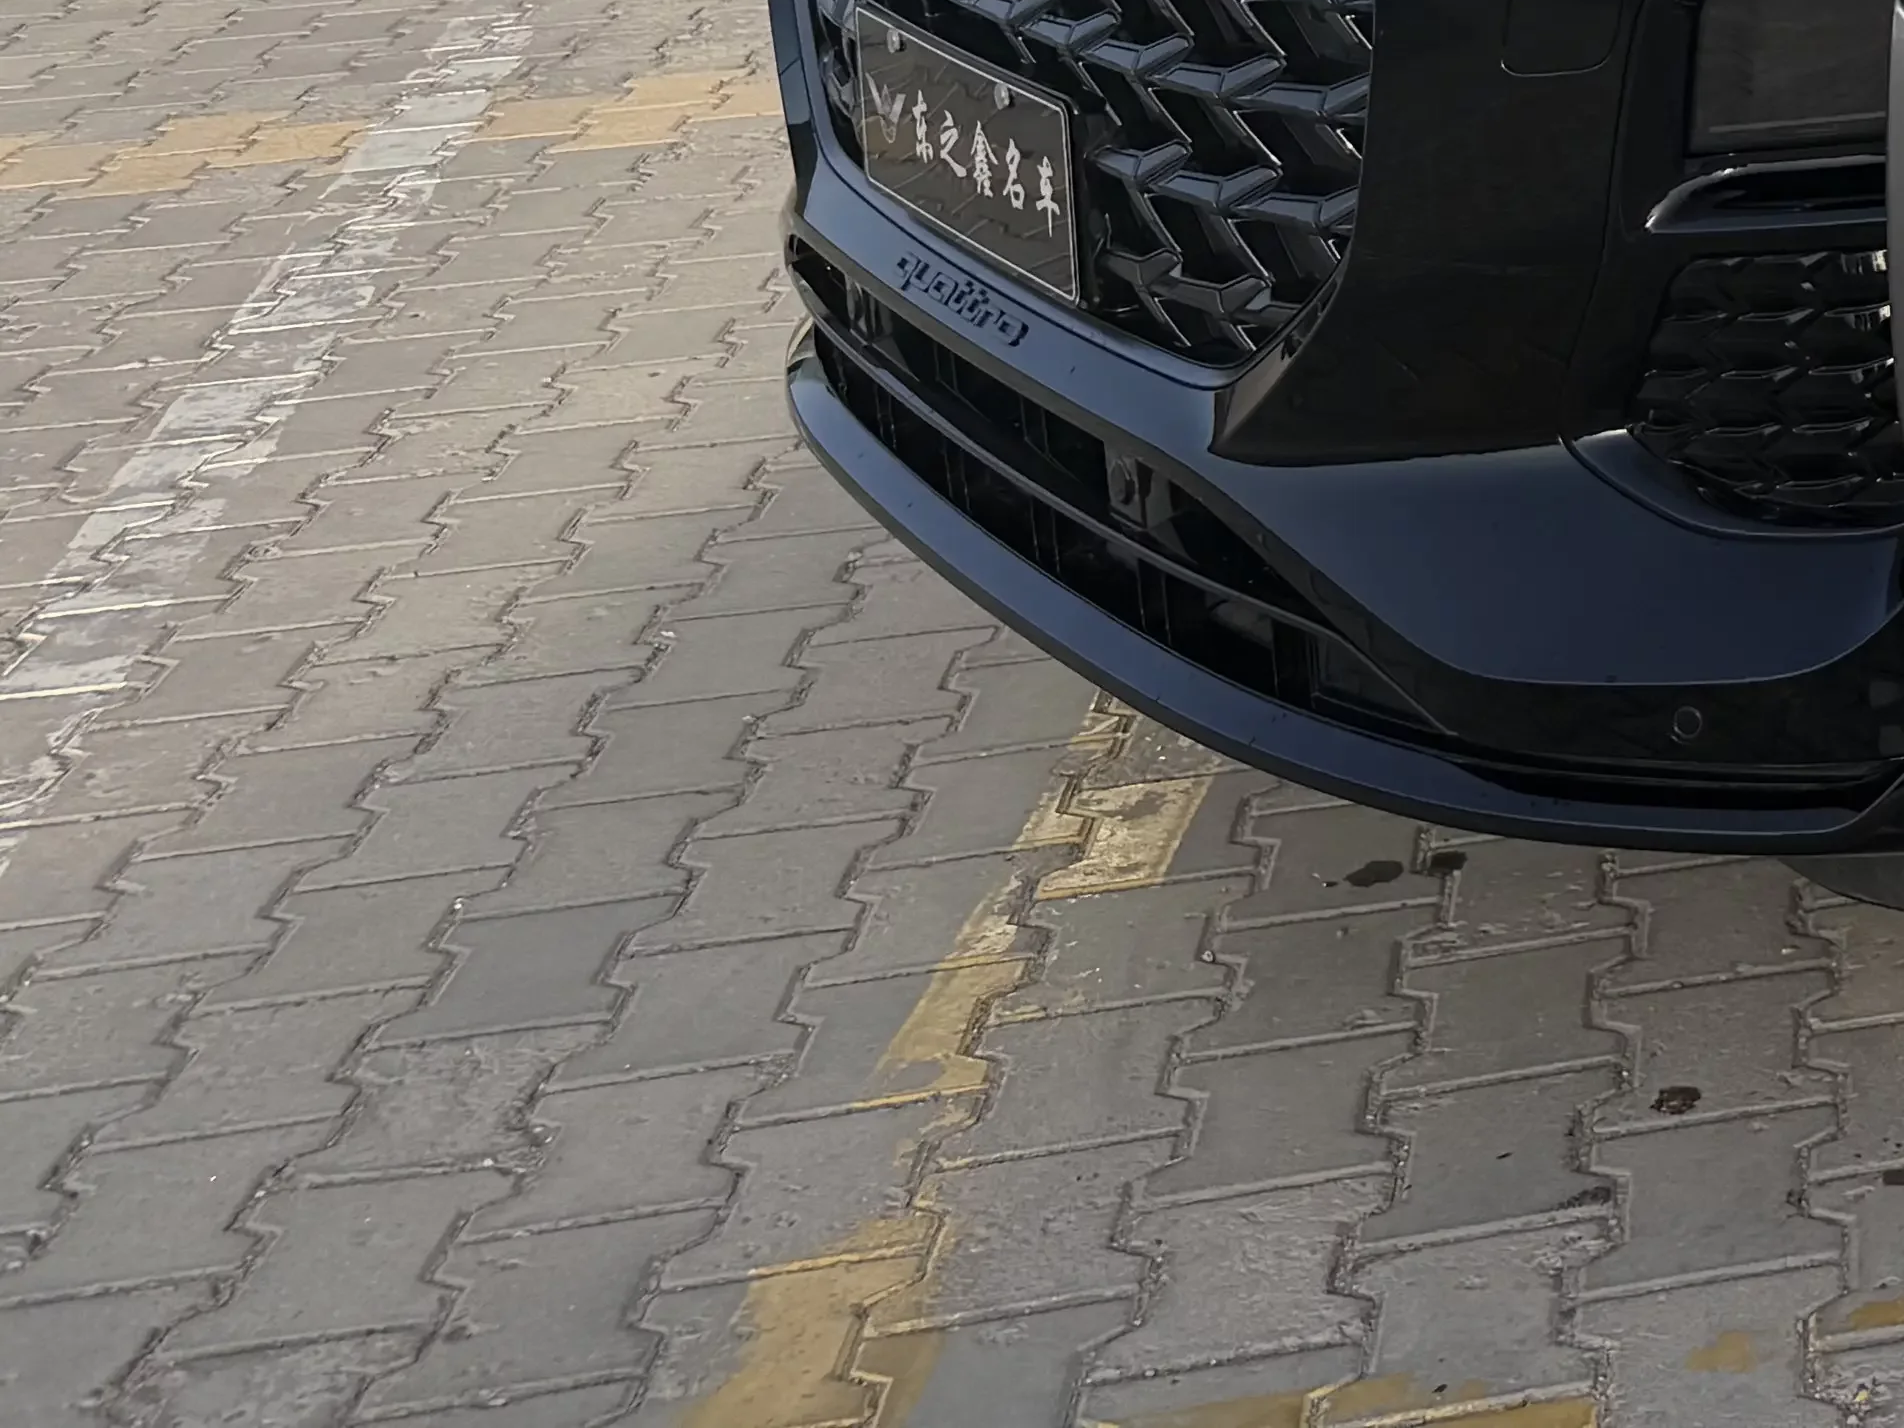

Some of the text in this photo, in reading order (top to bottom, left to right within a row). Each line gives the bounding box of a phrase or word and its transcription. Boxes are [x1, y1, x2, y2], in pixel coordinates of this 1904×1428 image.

[911, 89, 1061, 238] 东之鑫名车
[895, 251, 1030, 348] quattro
